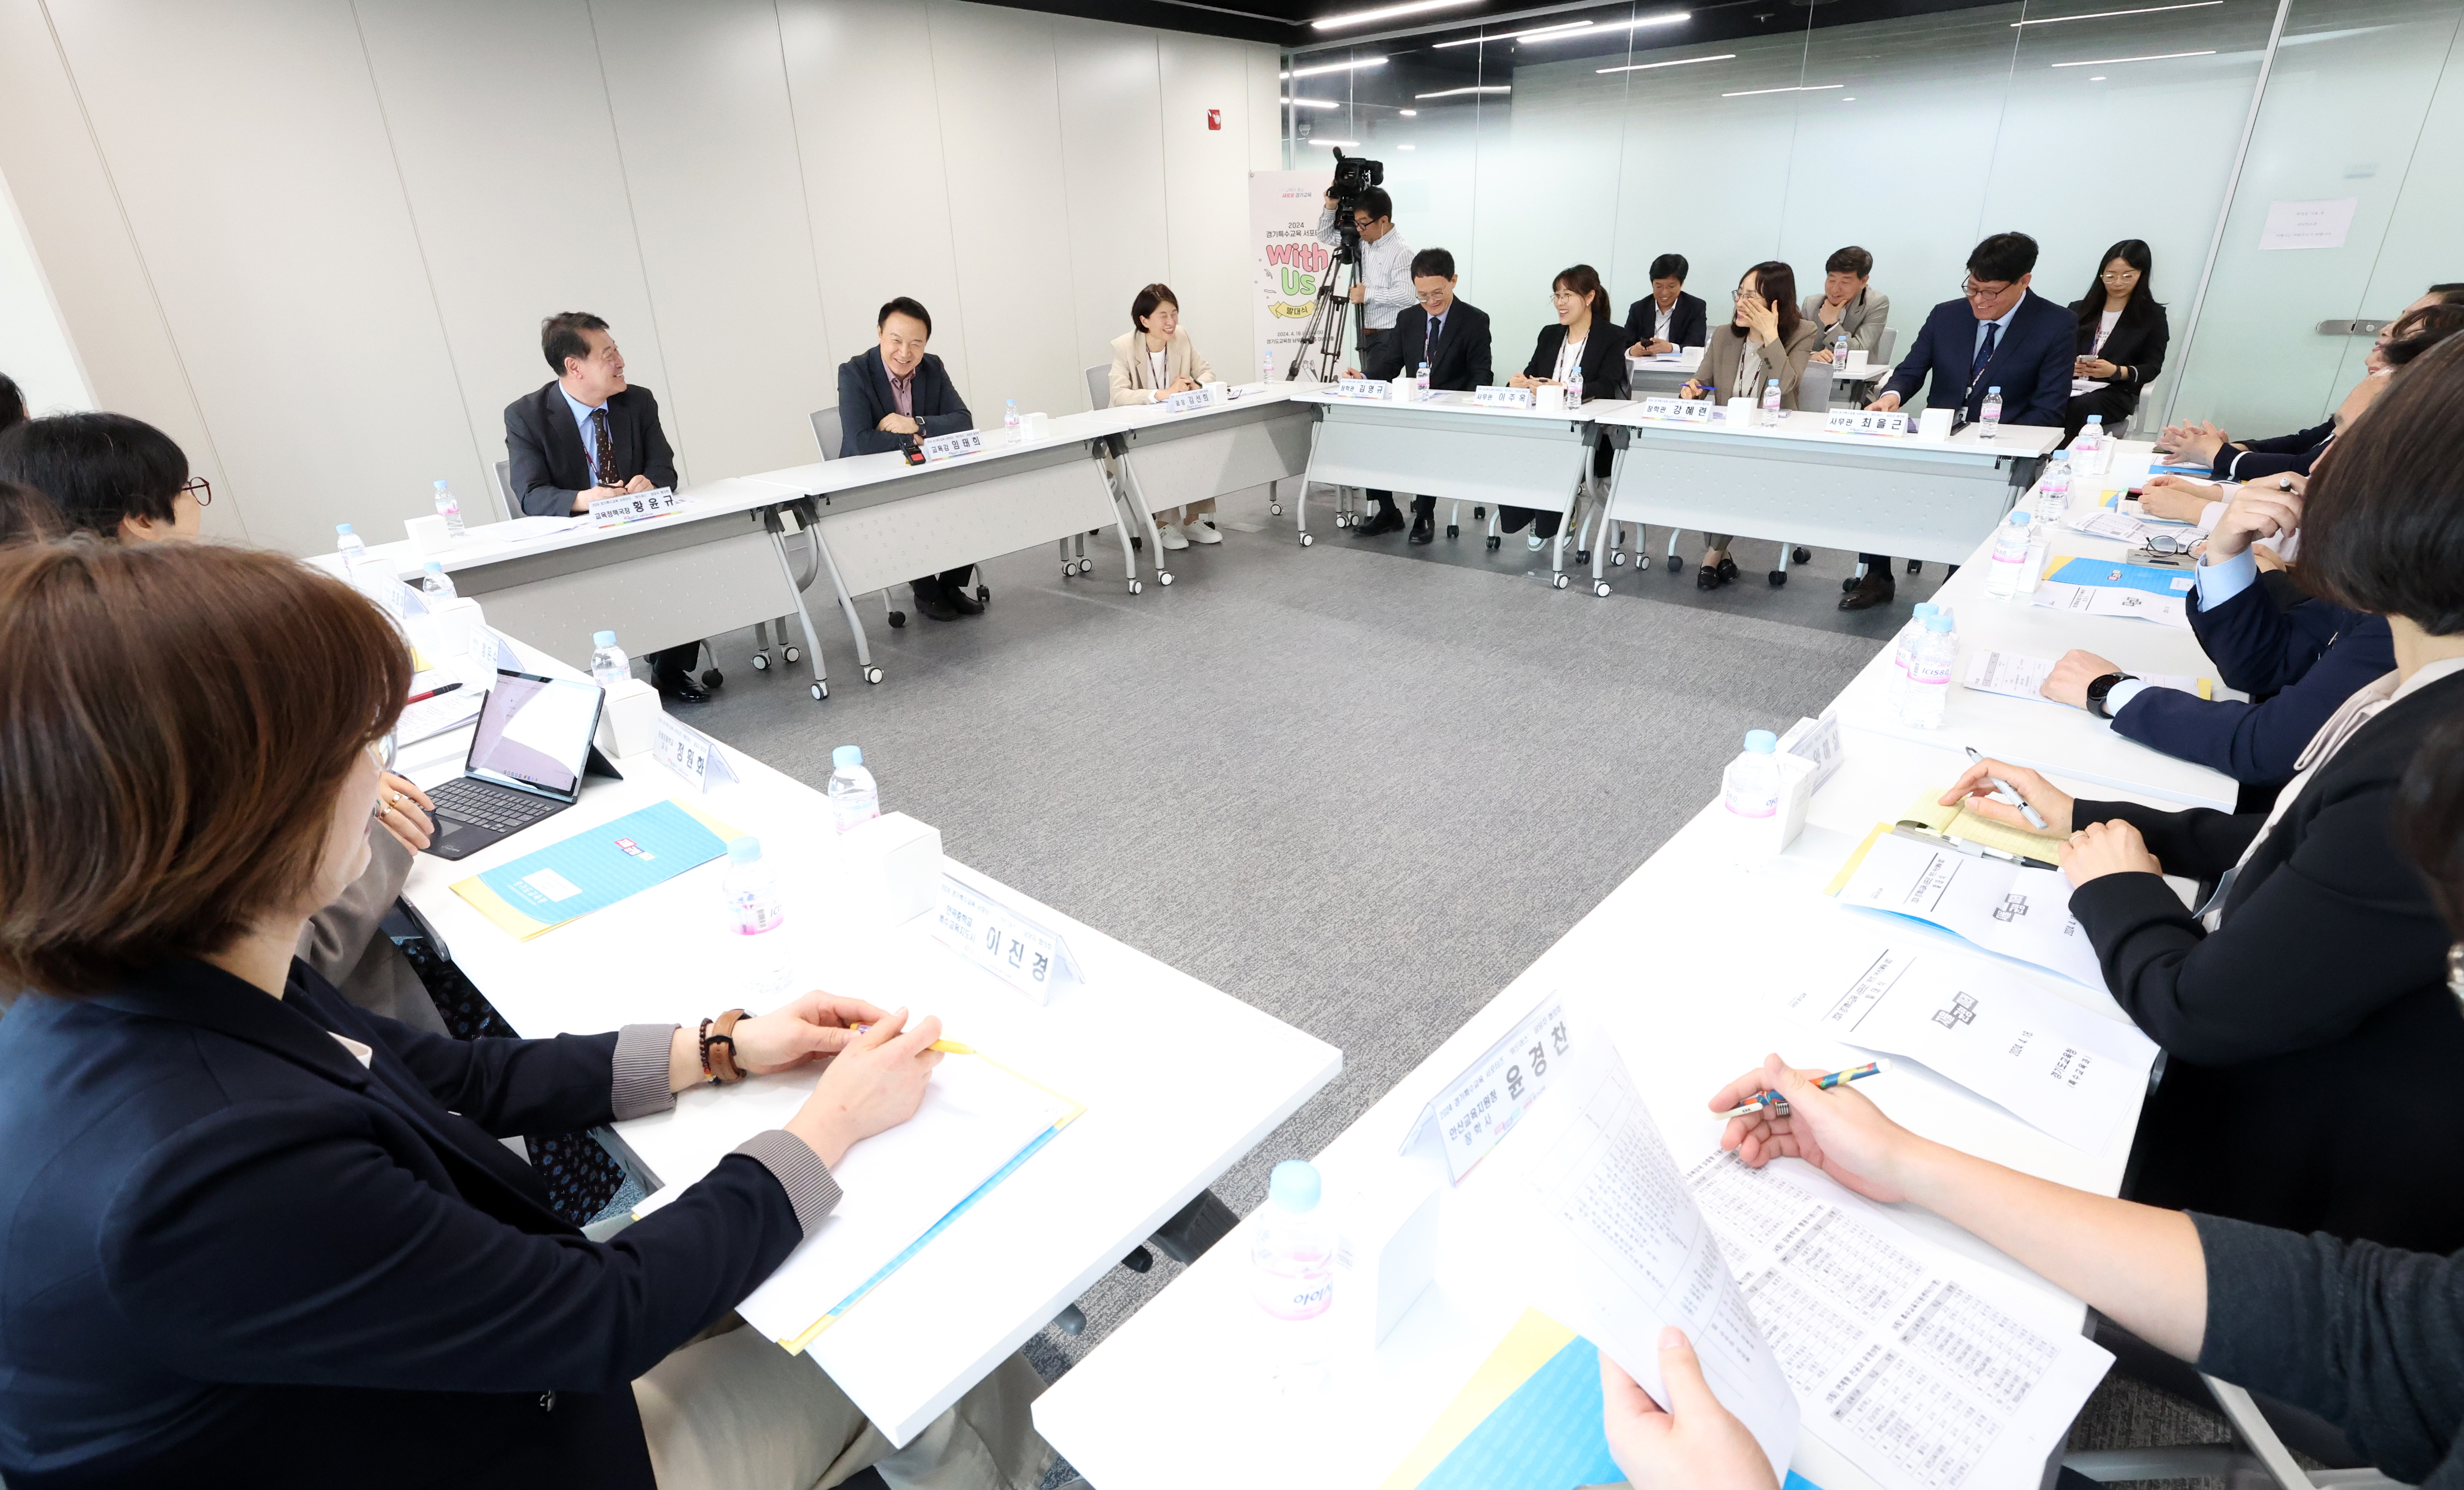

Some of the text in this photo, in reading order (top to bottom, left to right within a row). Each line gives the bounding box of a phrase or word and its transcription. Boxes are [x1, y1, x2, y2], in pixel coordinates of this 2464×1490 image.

[1266, 242, 1328, 272] With
[1281, 267, 1316, 296] Us
[1286, 306, 1308, 315] 발대식
[1188, 393, 1209, 404] 김선희
[1359, 385, 1383, 394] 김영규
[1499, 393, 1526, 403] 이주옥
[1673, 405, 1707, 417] 강혜련
[1830, 417, 1902, 430] 사무관 최을근
[931, 436, 981, 454] 교육감 임태희
[595, 495, 674, 520] 교육정책국장 황윤규
[677, 742, 704, 777] 정원화
[938, 914, 976, 944] 특수교육지도사
[941, 883, 950, 893] 2024
[952, 889, 976, 908] 경기특수교육
[1023, 929, 1036, 942] 담당자
[1038, 938, 1052, 951] 협의회
[946, 905, 973, 928] 안곡중학교
[986, 926, 1049, 983] 이진경
[1832, 1012, 1843, 1021] 2024
[1839, 995, 1860, 1013] 경기특수교육
[1855, 983, 1870, 996] 서포터즈
[1864, 981, 1887, 1000] 발대식
[1935, 1011, 1955, 1027] 자율
[1953, 1005, 1973, 1023] 균형
[1439, 1103, 1453, 1121] 2024
[1454, 1075, 1484, 1107] 경기특수교육
[1486, 1056, 1505, 1079] 서포터즈
[1533, 1017, 1547, 1035] 담당자
[1548, 1004, 1562, 1022] 협의회
[1506, 1020, 1569, 1101] 윤경찬
[2009, 1043, 2024, 1057] 2024.
[2050, 1047, 2077, 1079] 경기도교육청
[2066, 1055, 2093, 1089] (특수교육과)
[1449, 1088, 1498, 1141] 안산교육지원청
[1464, 1112, 1492, 1146] 장학사
